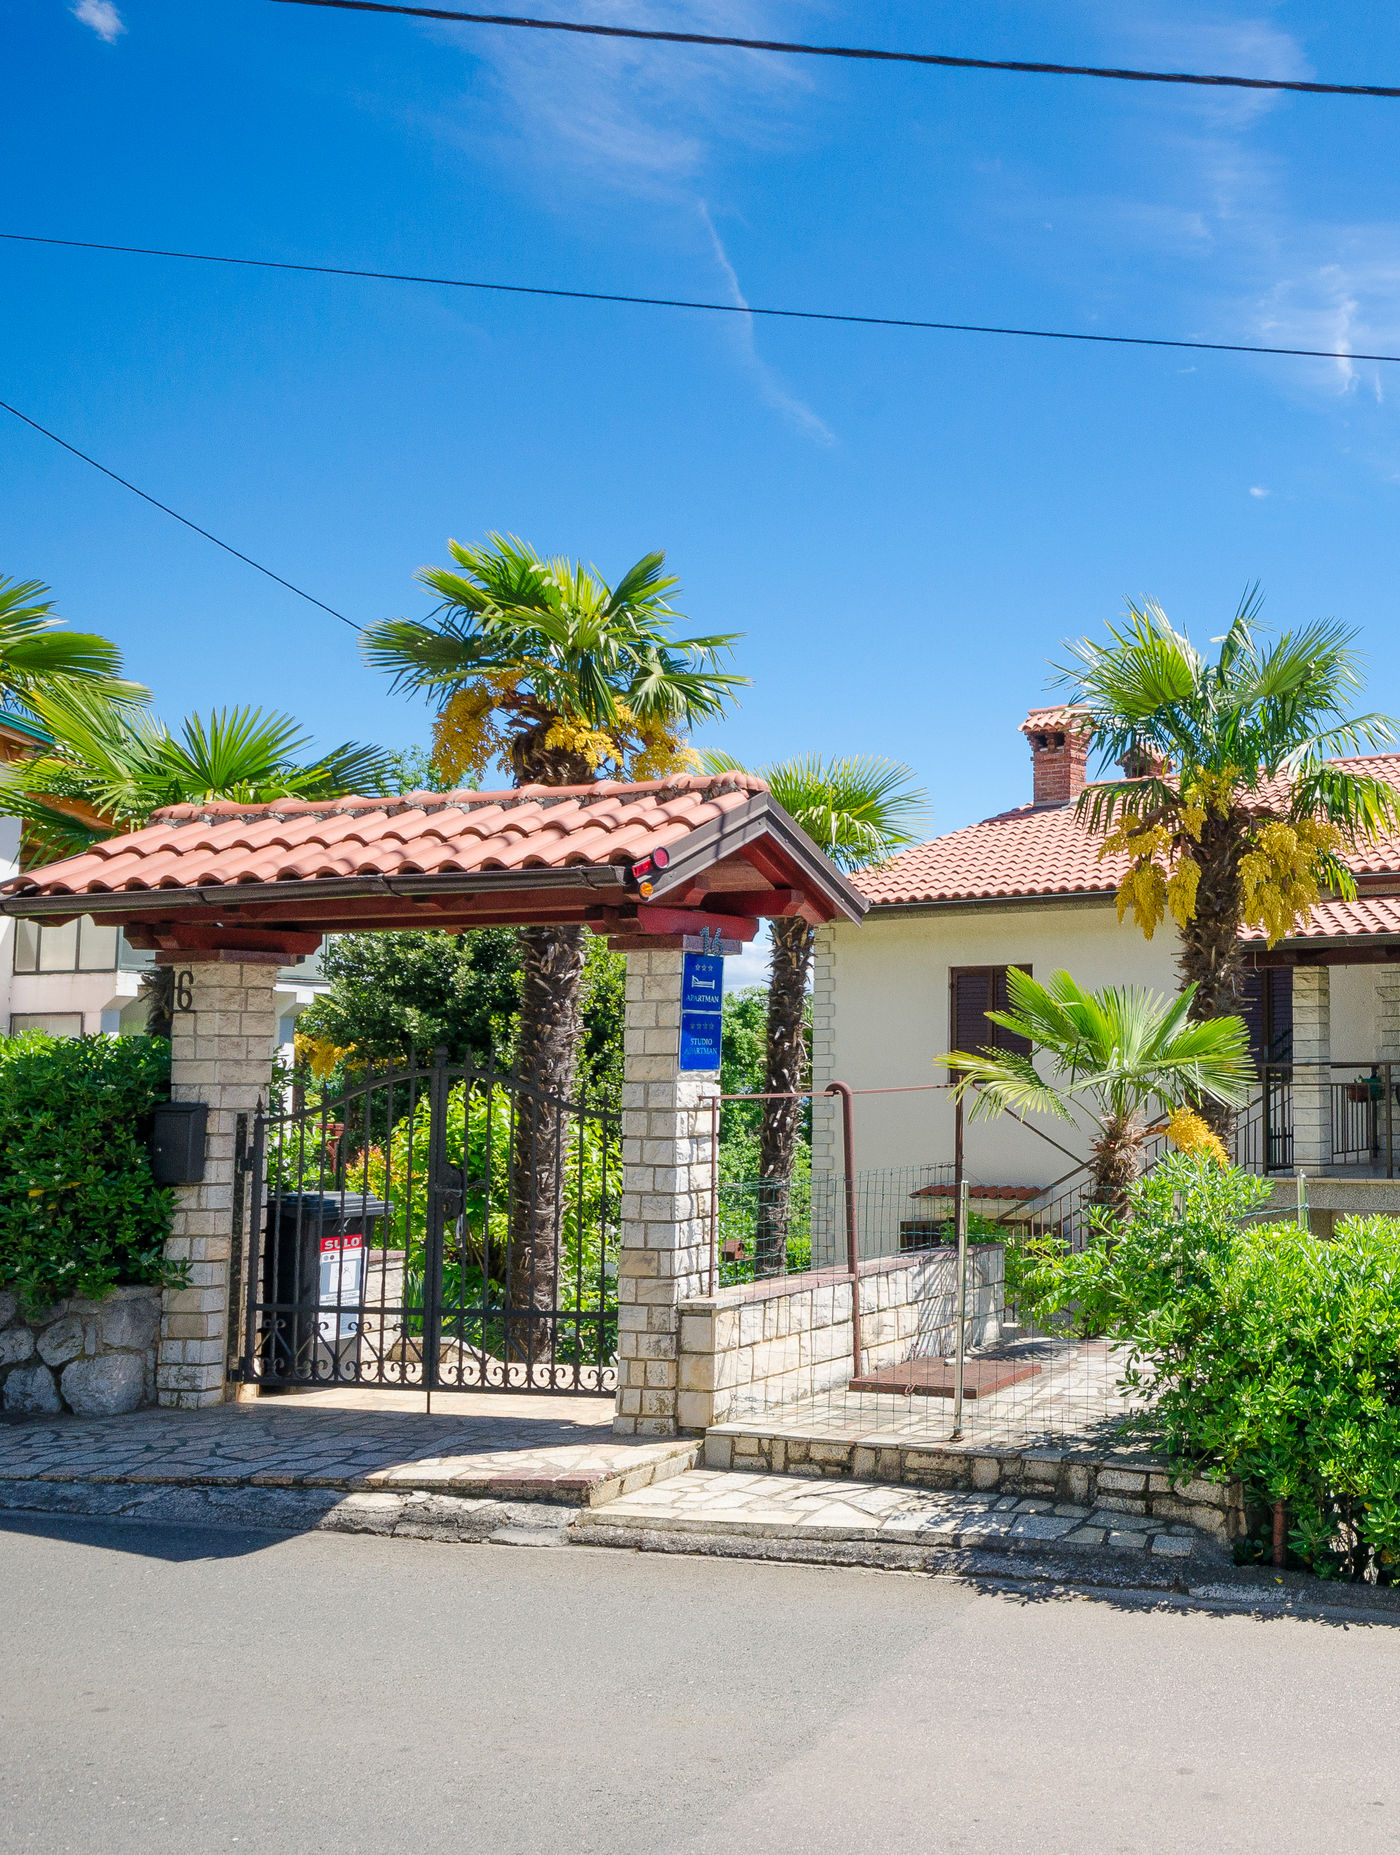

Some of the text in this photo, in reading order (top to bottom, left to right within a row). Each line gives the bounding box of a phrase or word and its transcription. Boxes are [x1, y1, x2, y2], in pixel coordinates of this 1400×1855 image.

[700, 926, 723, 957] 16
[686, 994, 720, 1003] APARTMAN
[690, 1037, 713, 1046] STUDIO
[684, 1047, 718, 1055] APARTMAN
